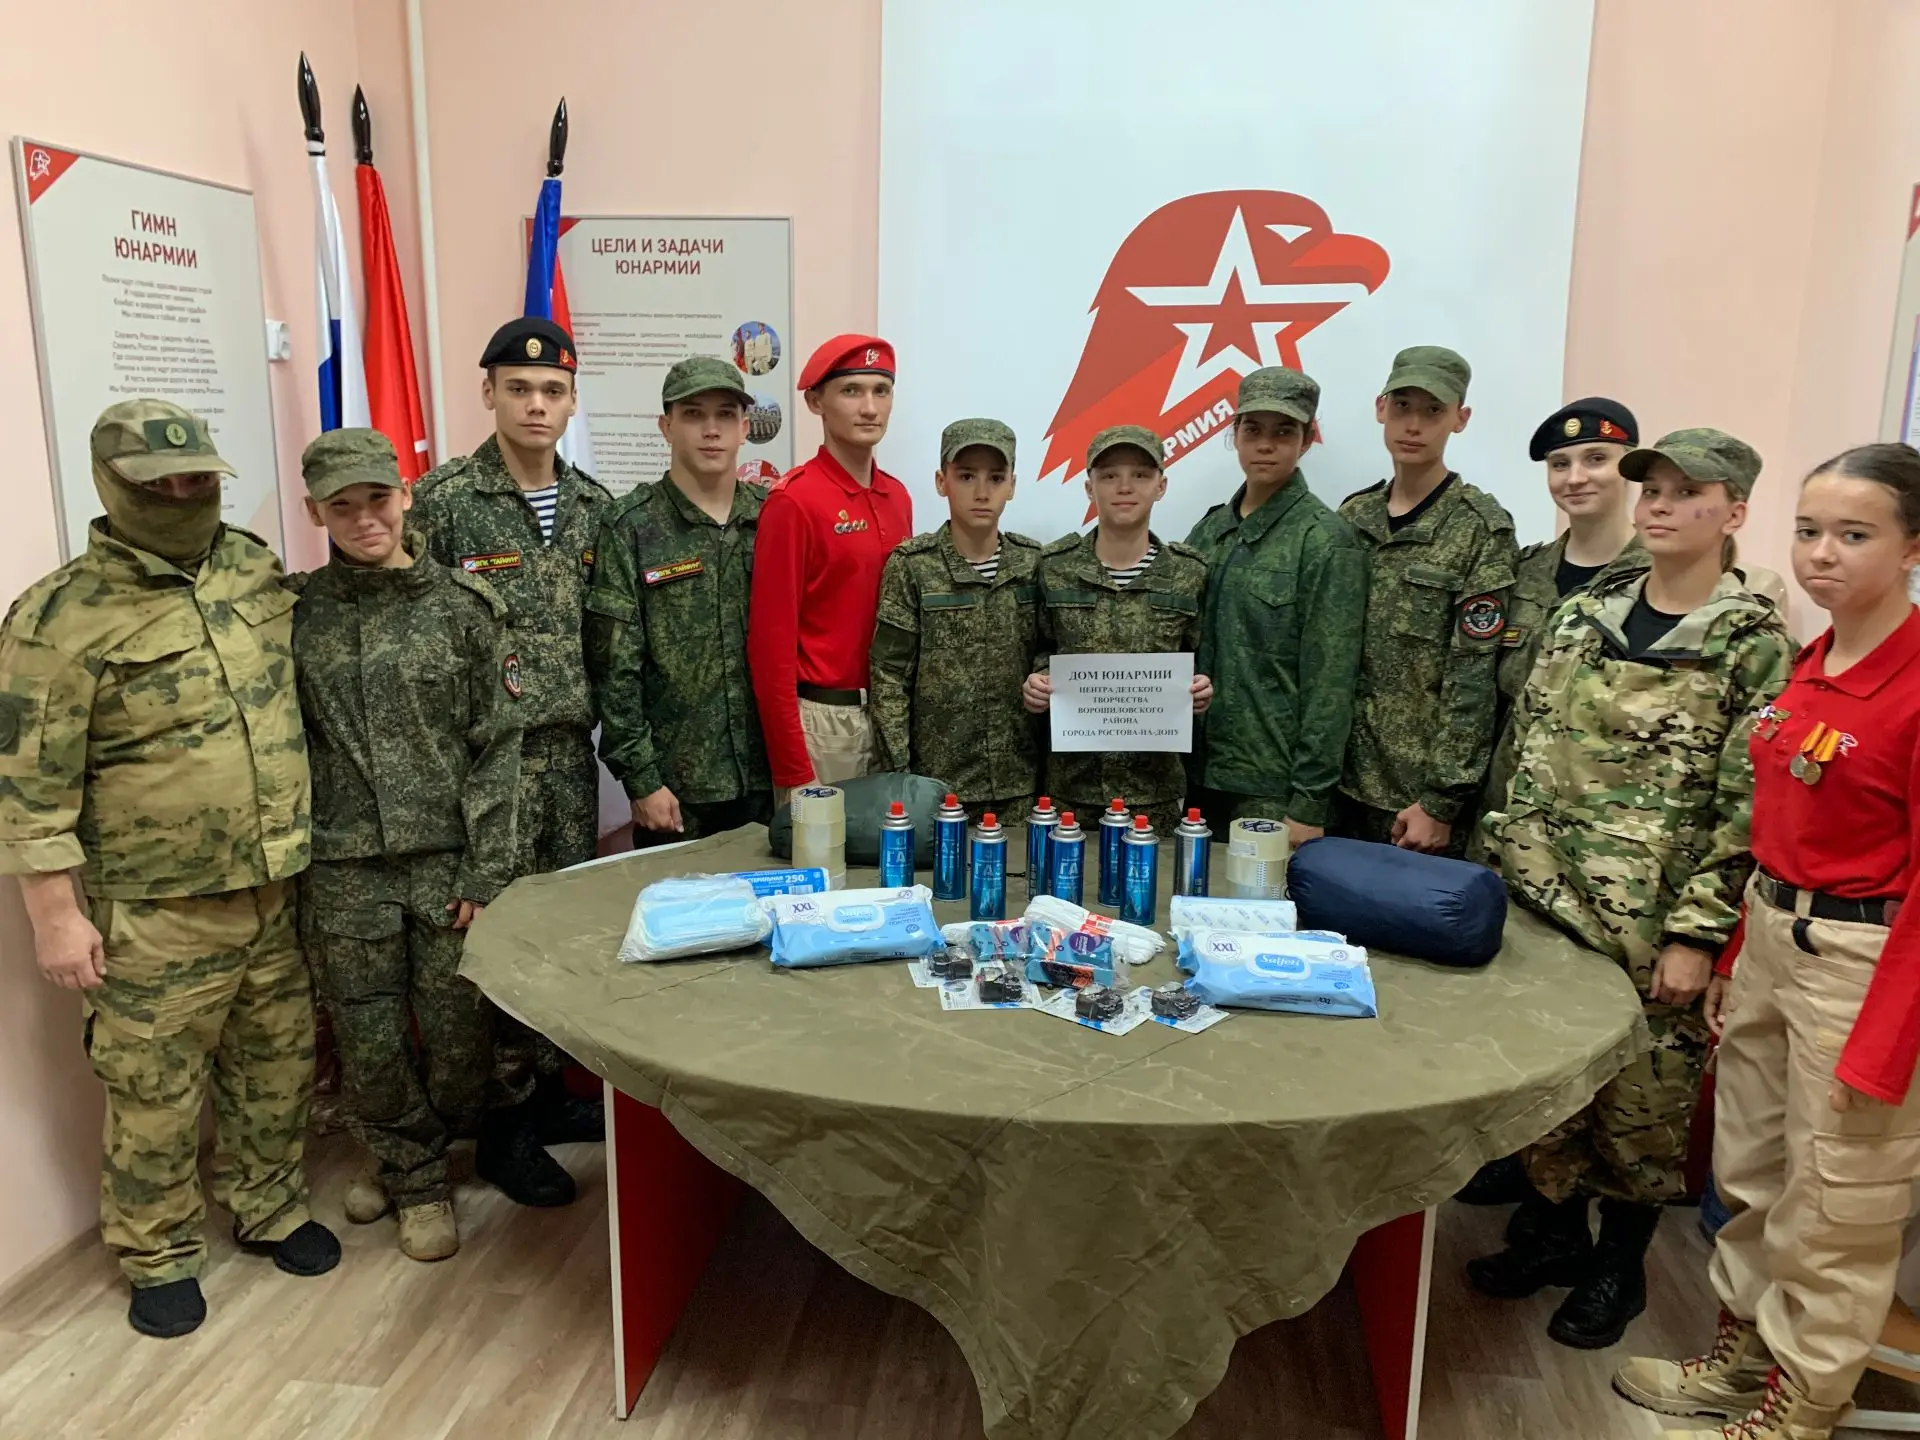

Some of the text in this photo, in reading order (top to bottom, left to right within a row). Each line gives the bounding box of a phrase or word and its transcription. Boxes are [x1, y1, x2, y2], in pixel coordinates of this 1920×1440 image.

[131, 209, 177, 238] ГИМН
[114, 236, 198, 269] ЮНАРМИИ
[592, 238, 724, 256] ЦЕЛИ И ЗАДАЧИ
[615, 259, 701, 275] ЮНАРМИИ
[1162, 398, 1235, 462] РМИЯ
[1068, 669, 1172, 681] ДОМ ЮНАРМИИ
[1115, 686, 1162, 694] ДЕТСКОГО
[1093, 696, 1148, 704] ТВОРЧЕСТВА
[1102, 716, 1138, 725] РАЙОНА
[1062, 729, 1179, 737] ГОРОДА РОСТОВА-НА-ДОНУ
[792, 902, 815, 913] XXL
[1212, 942, 1236, 952] XXL
